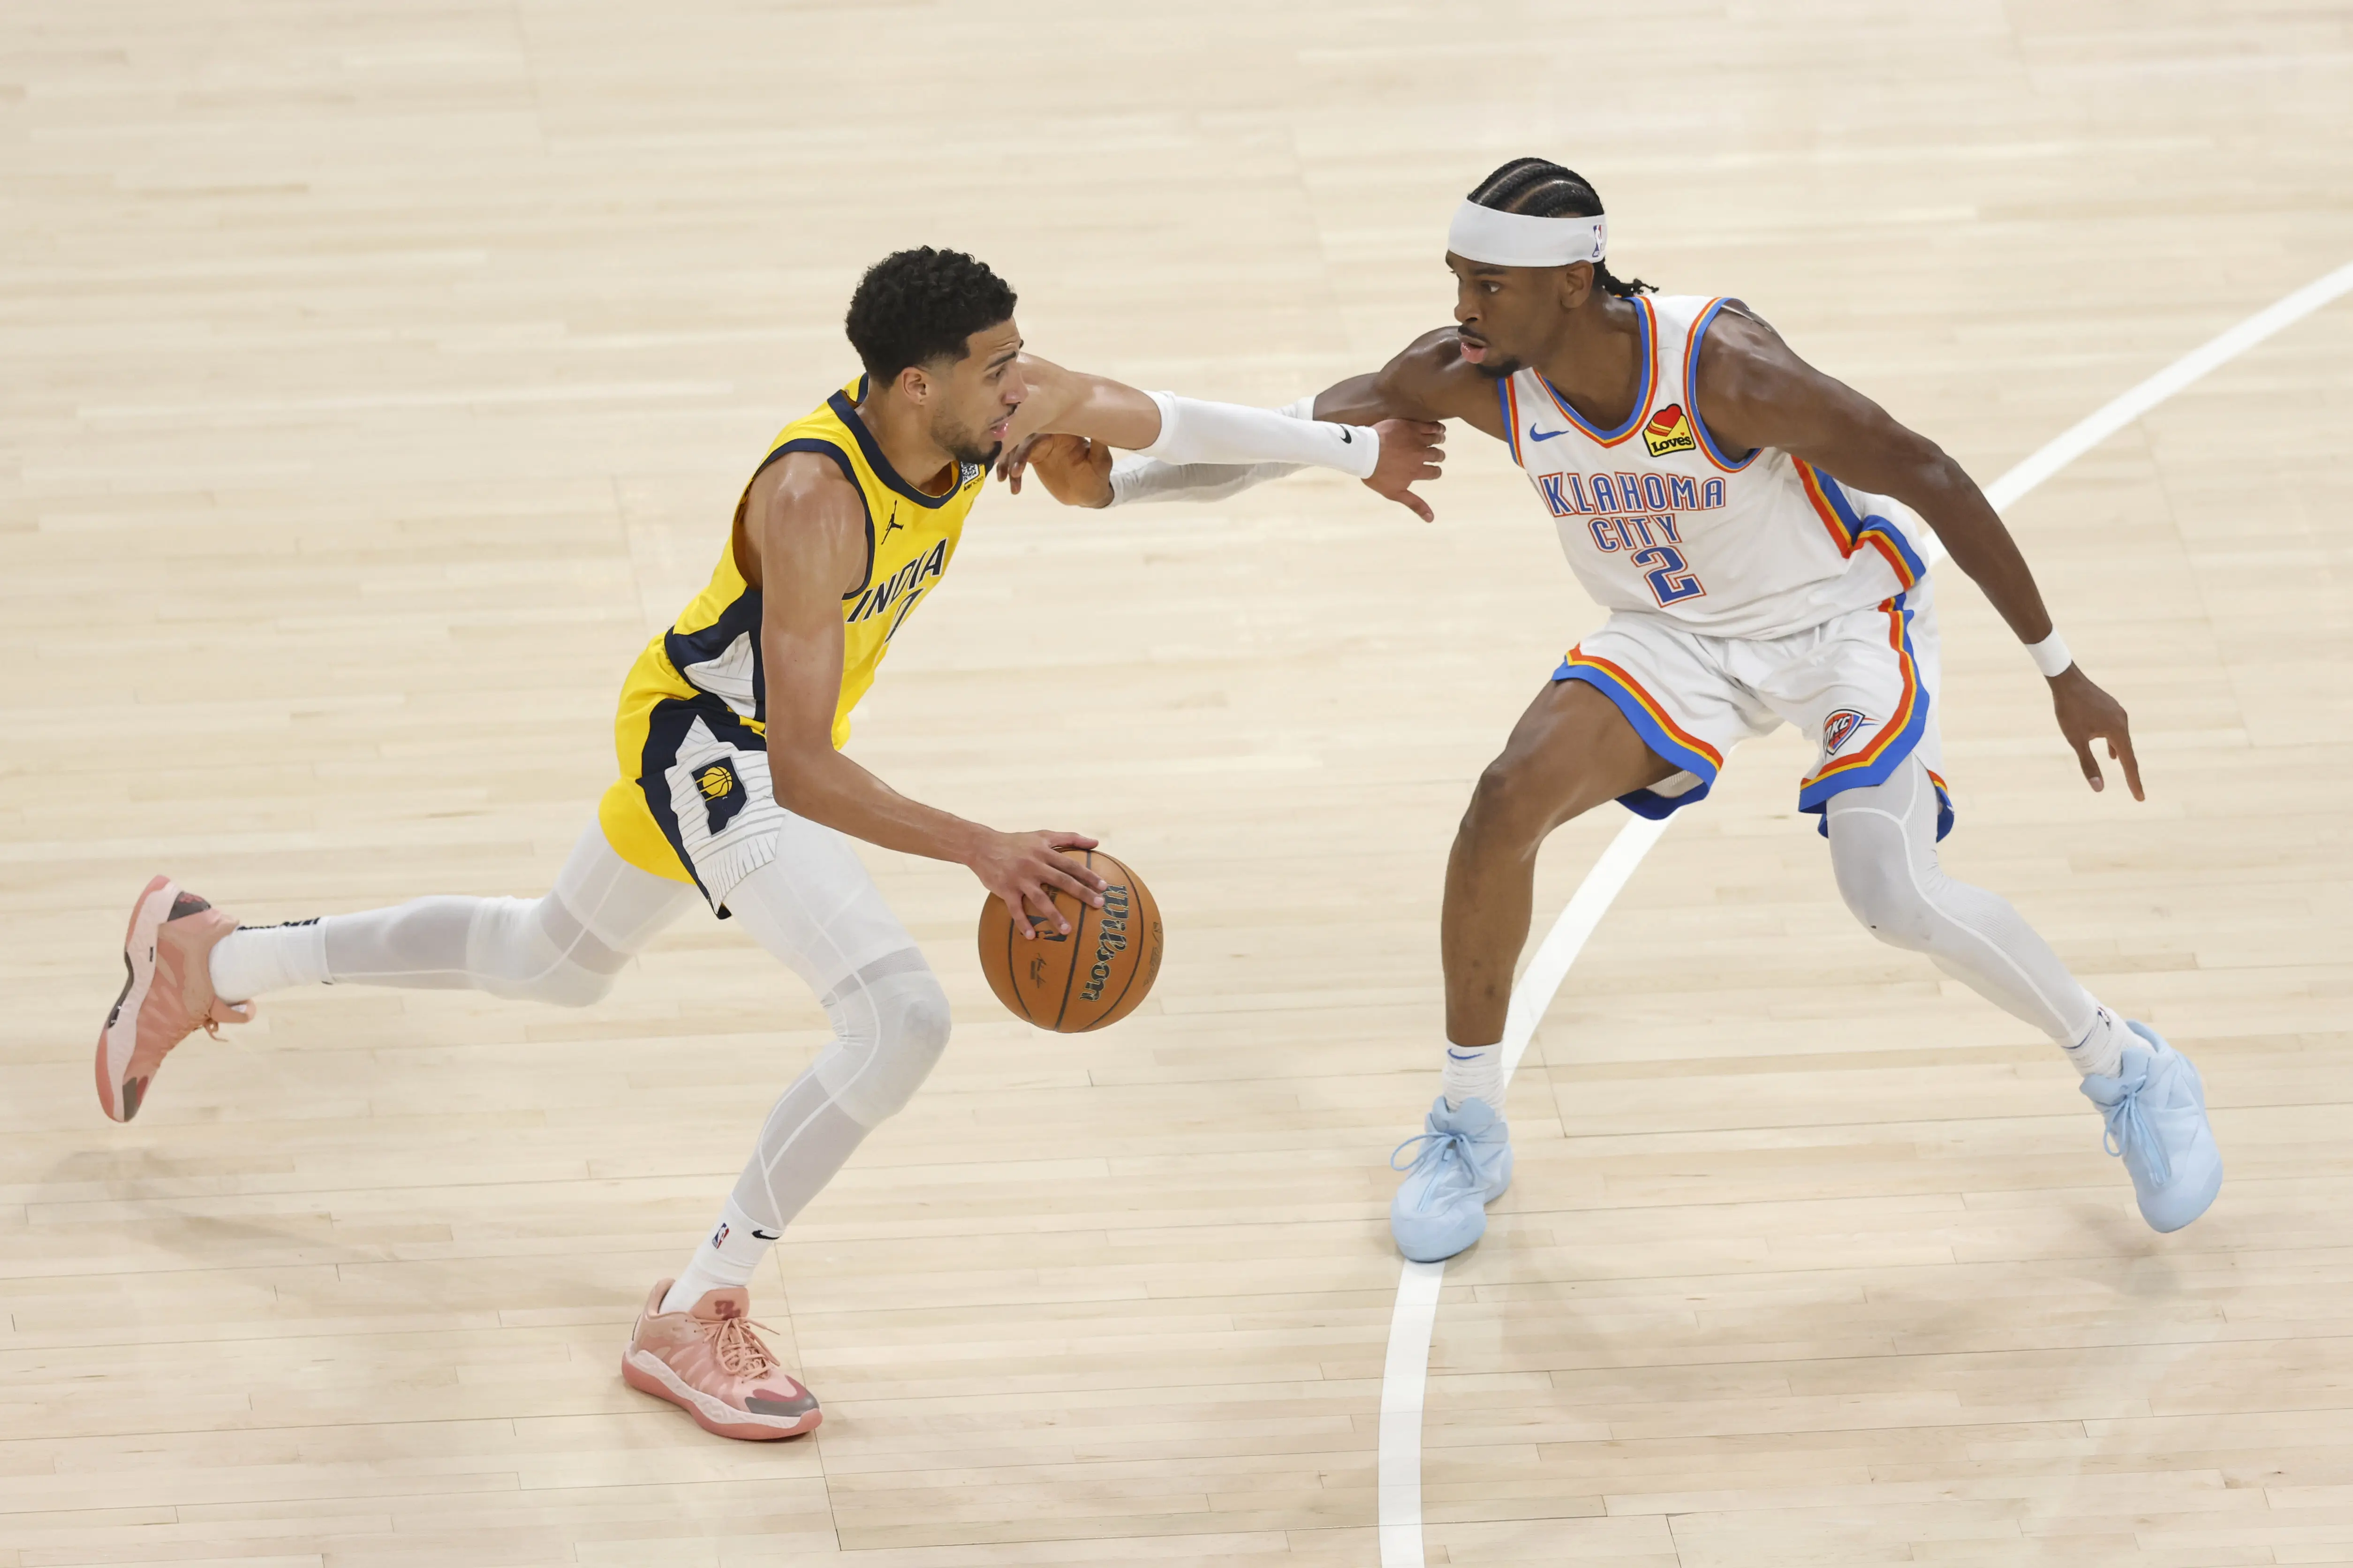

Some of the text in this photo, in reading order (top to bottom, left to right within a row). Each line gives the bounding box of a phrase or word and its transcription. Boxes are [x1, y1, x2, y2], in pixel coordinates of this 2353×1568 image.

[1588, 513, 1682, 552] CITY
[1630, 545, 1707, 608] 2
[1080, 884, 1129, 1002] Wilson
